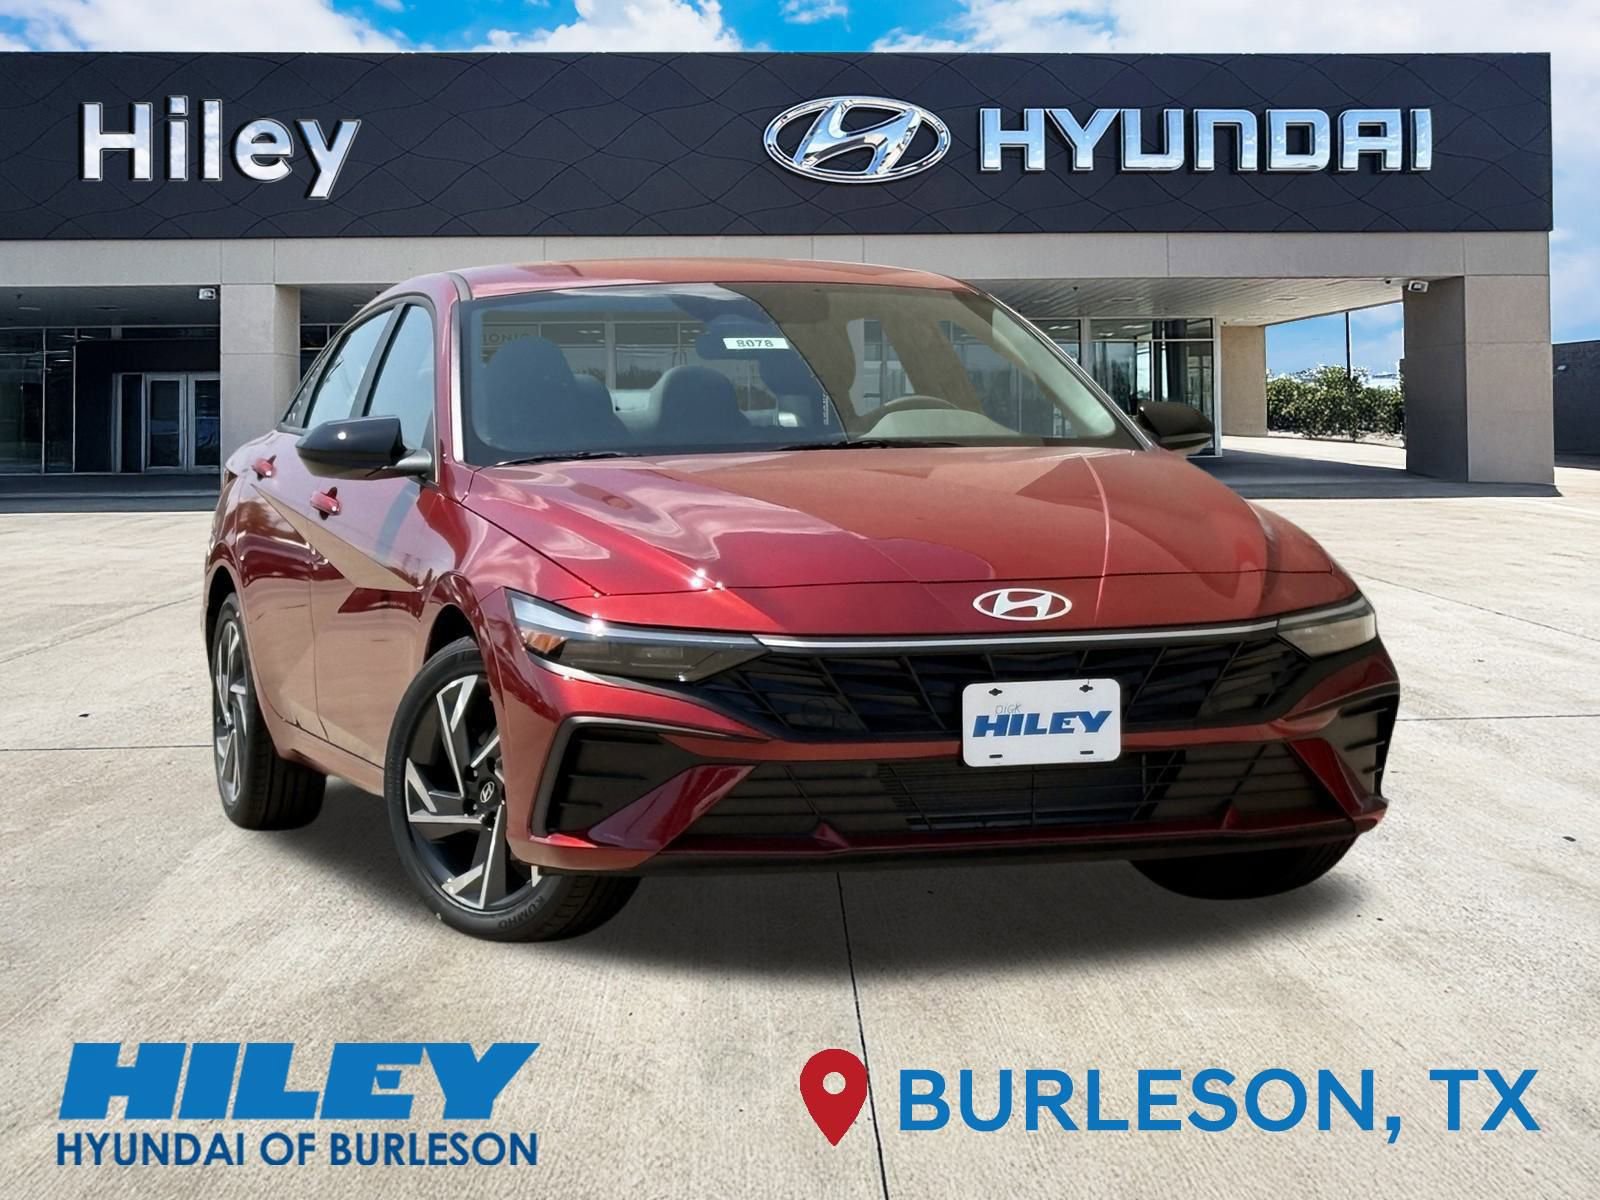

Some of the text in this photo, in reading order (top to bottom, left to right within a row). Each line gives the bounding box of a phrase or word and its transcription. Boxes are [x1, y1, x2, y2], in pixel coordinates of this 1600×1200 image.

[81, 95, 361, 199] Hiley
[979, 108, 1432, 171] HYUNDAI
[735, 339, 775, 348] 8078
[972, 710, 1113, 737] HILEY
[498, 895, 546, 930] KUMHO
